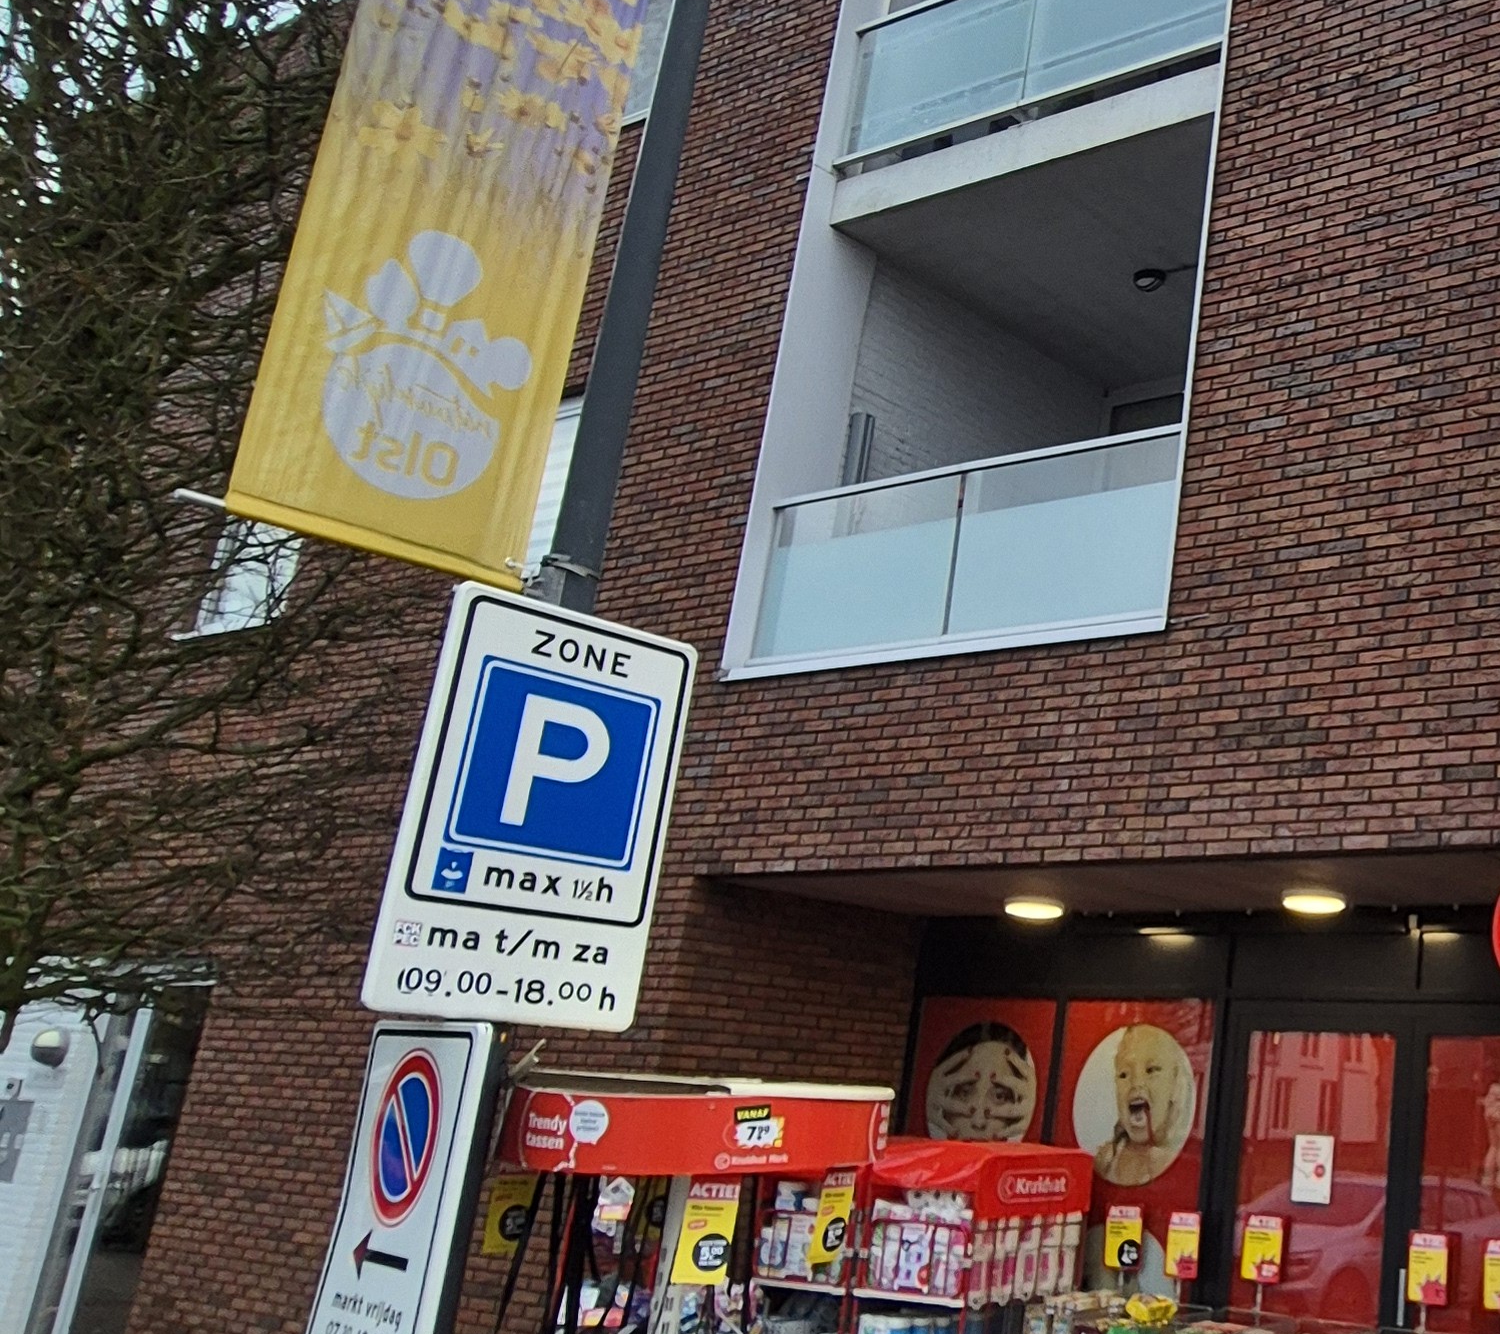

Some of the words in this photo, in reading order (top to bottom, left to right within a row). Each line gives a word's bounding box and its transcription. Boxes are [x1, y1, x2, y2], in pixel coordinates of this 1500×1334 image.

[531, 630, 632, 679] ZONE
[499, 693, 610, 827] P
[483, 866, 561, 897] max
[427, 926, 481, 951] ma
[494, 928, 561, 961] t/m
[572, 943, 609, 966] za
[599, 986, 616, 1011] h
[526, 1131, 564, 1150] tassen
[529, 1112, 567, 1136] Trendy
[331, 1291, 364, 1315] markt
[365, 1300, 402, 1334] vrijdag
